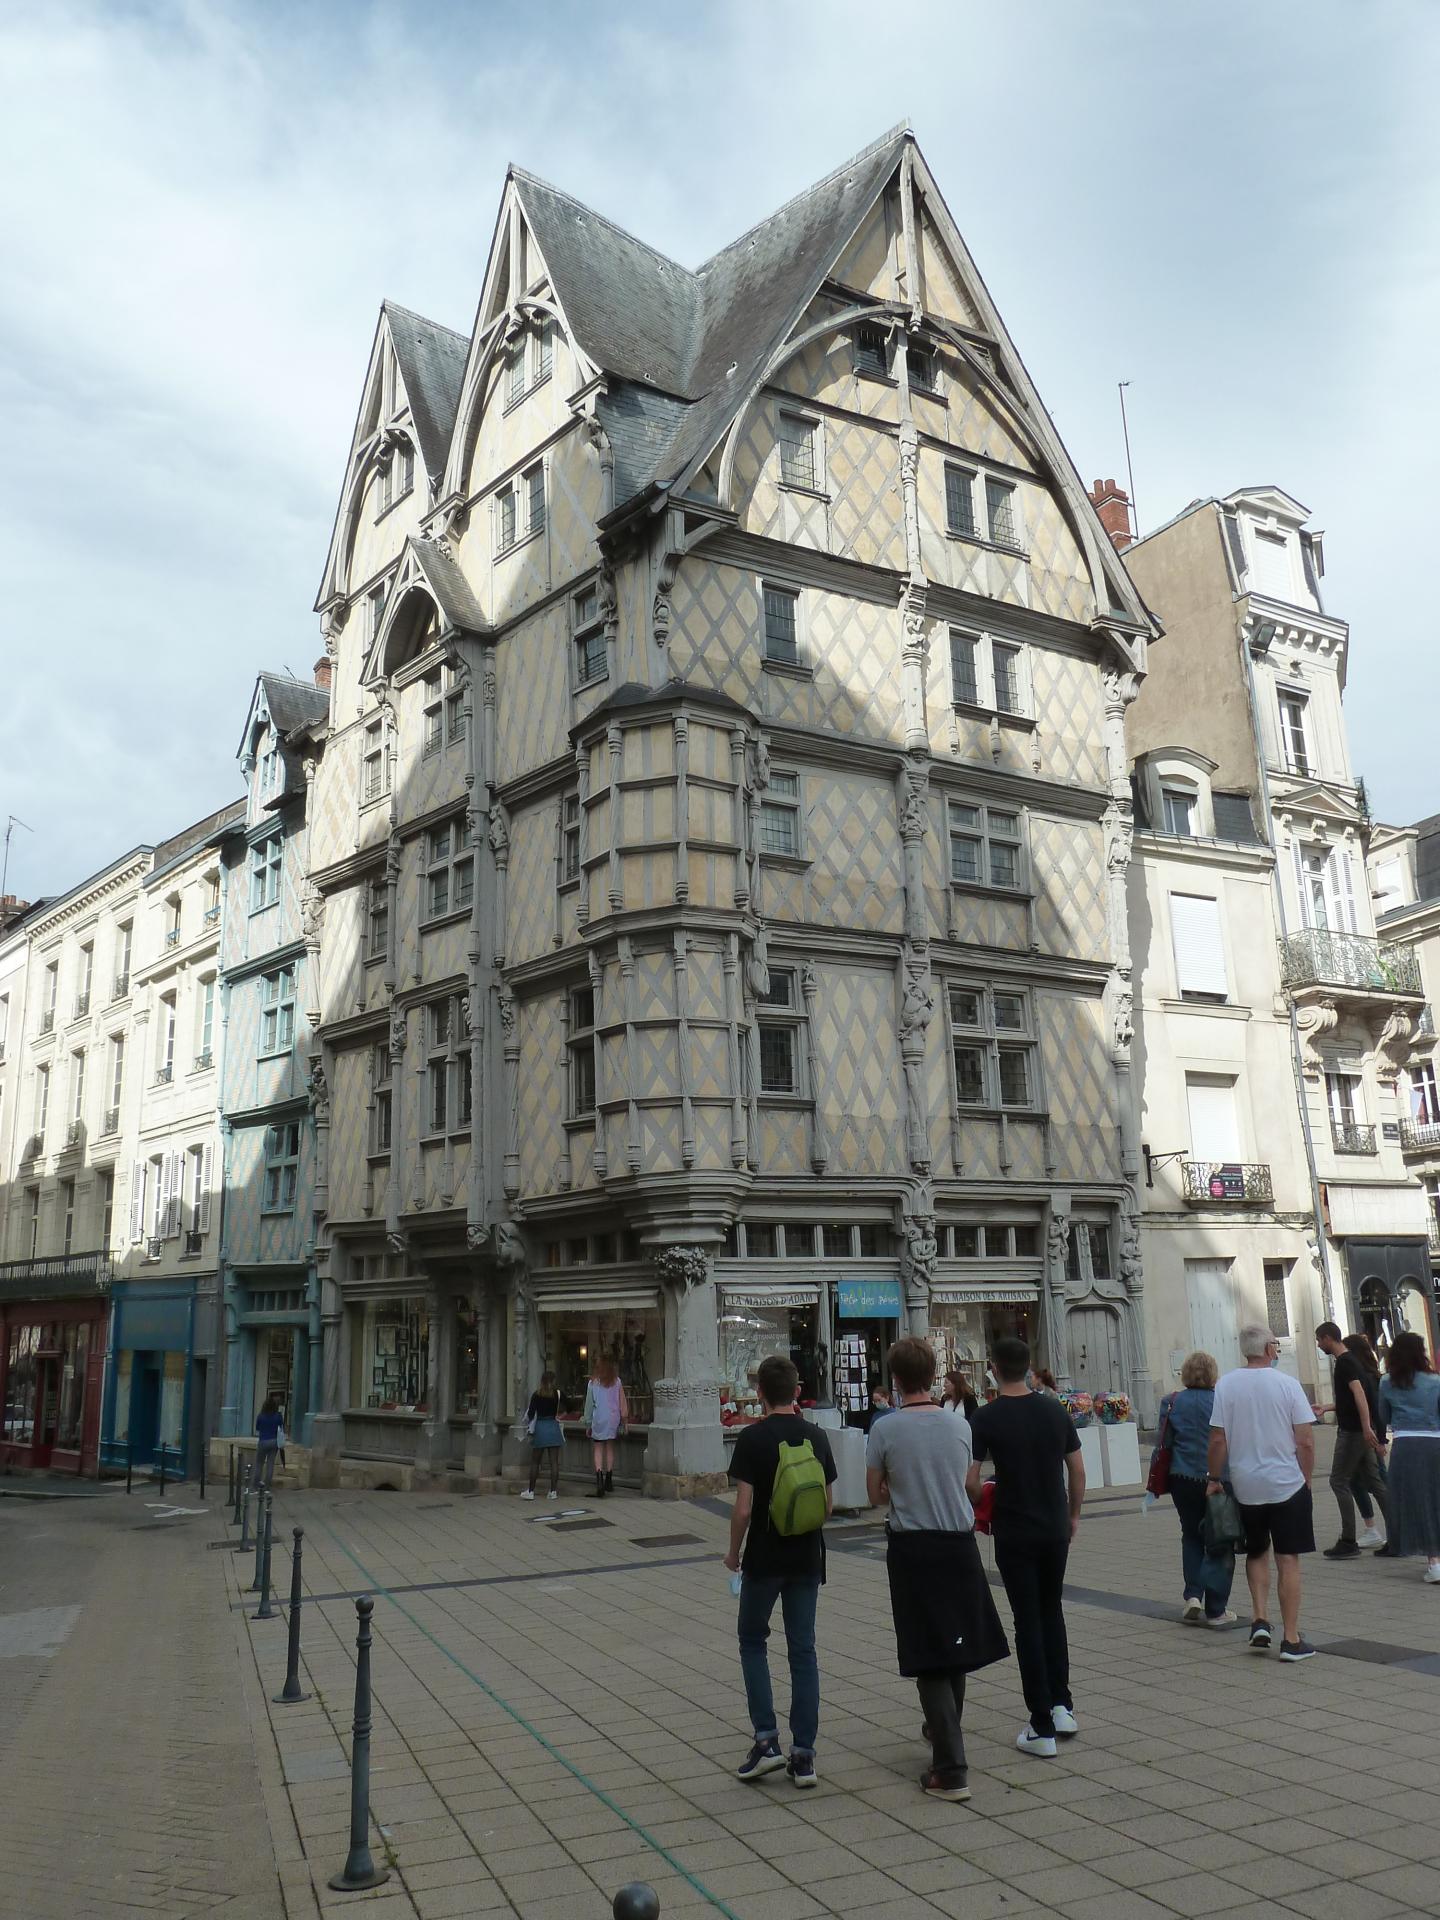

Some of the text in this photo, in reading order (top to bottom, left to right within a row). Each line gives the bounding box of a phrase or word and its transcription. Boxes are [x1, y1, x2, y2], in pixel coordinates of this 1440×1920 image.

[731, 1293, 813, 1306] LA MAISON D'ADAM
[861, 1291, 875, 1305] des
[940, 1291, 1031, 1302] LA MAISON DES ARTISANS
